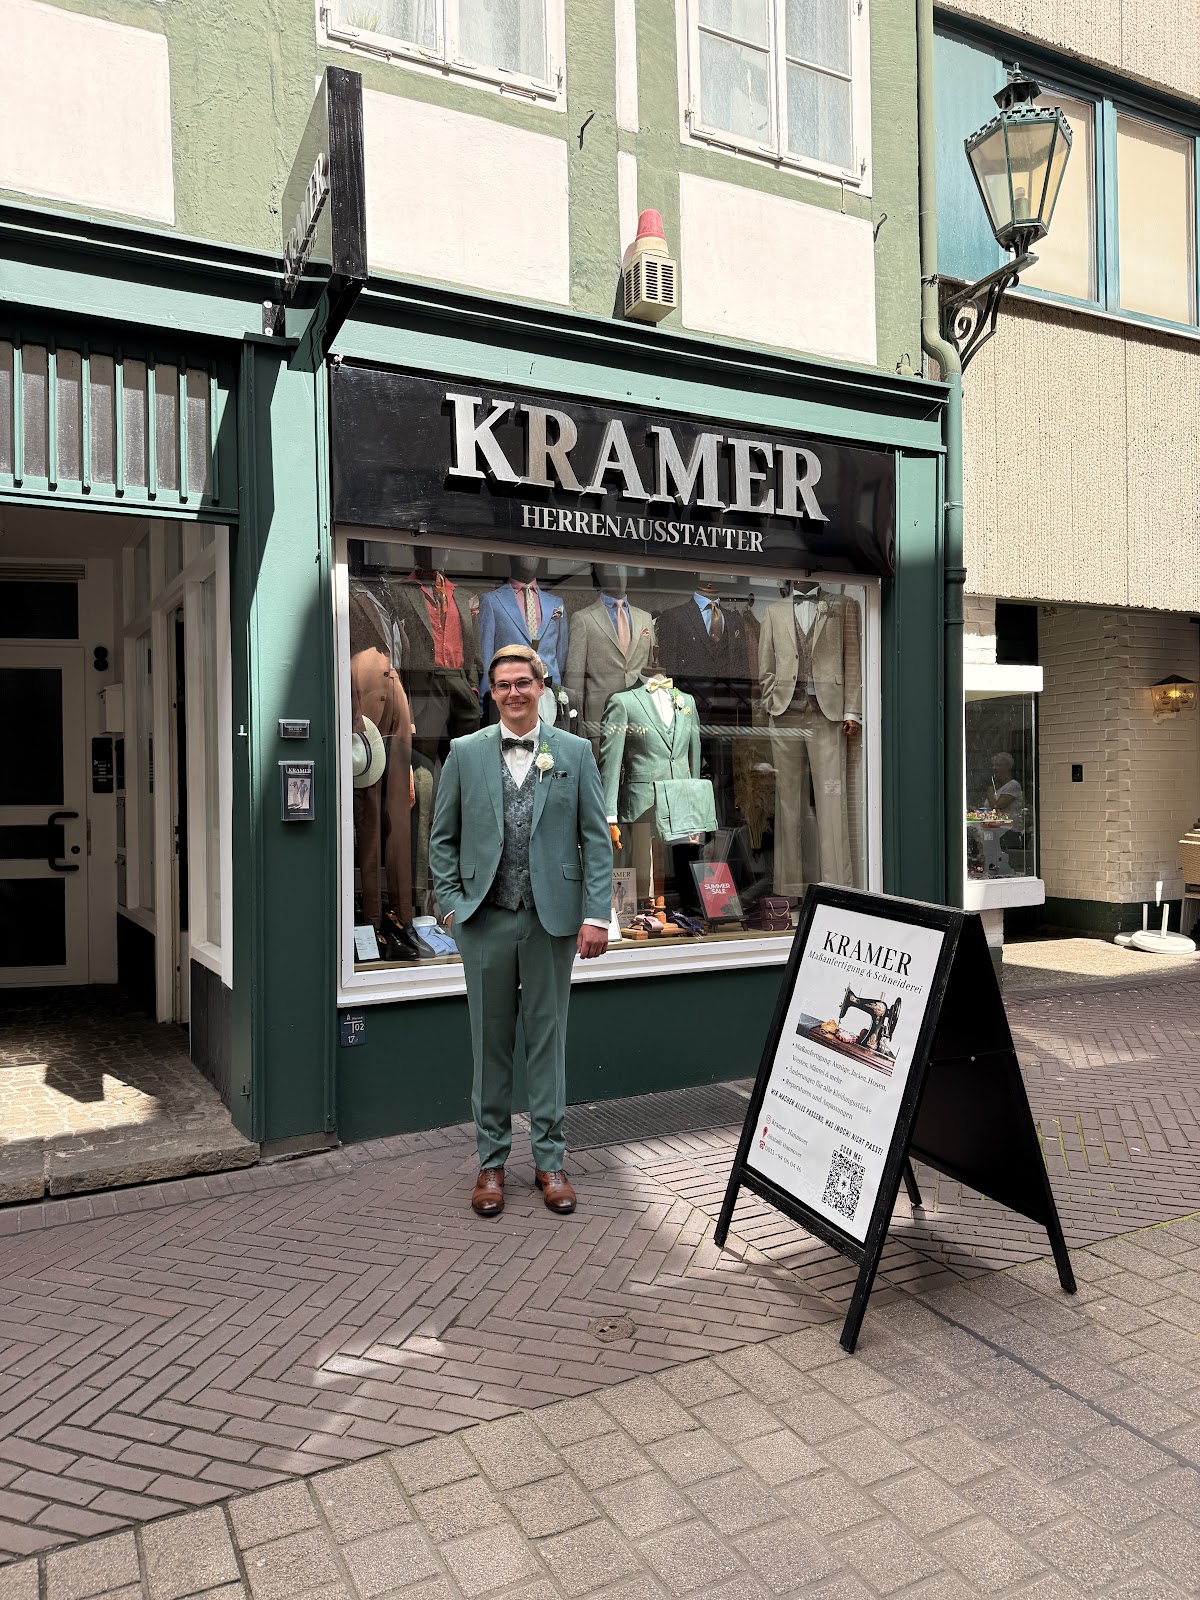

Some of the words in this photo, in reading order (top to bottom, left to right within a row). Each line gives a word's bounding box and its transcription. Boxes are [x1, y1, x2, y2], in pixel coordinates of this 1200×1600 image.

[444, 392, 830, 522] KRAMER
[521, 505, 764, 553] HERRENAUSSTATTER
[807, 950, 866, 978] Maßanfertigung
[866, 970, 873, 978] &
[873, 971, 924, 994] Schneiderei
[822, 931, 912, 976] KRAMER
[770, 1088, 779, 1097] WIR
[778, 1093, 796, 1106] MACHEN
[794, 1102, 807, 1113] ALLES
[825, 1119, 834, 1129] WAS
[851, 1133, 866, 1145] NICHT
[865, 1141, 884, 1156] PASST!
[840, 1144, 853, 1156] SCAN
[853, 1152, 864, 1163] ME!
